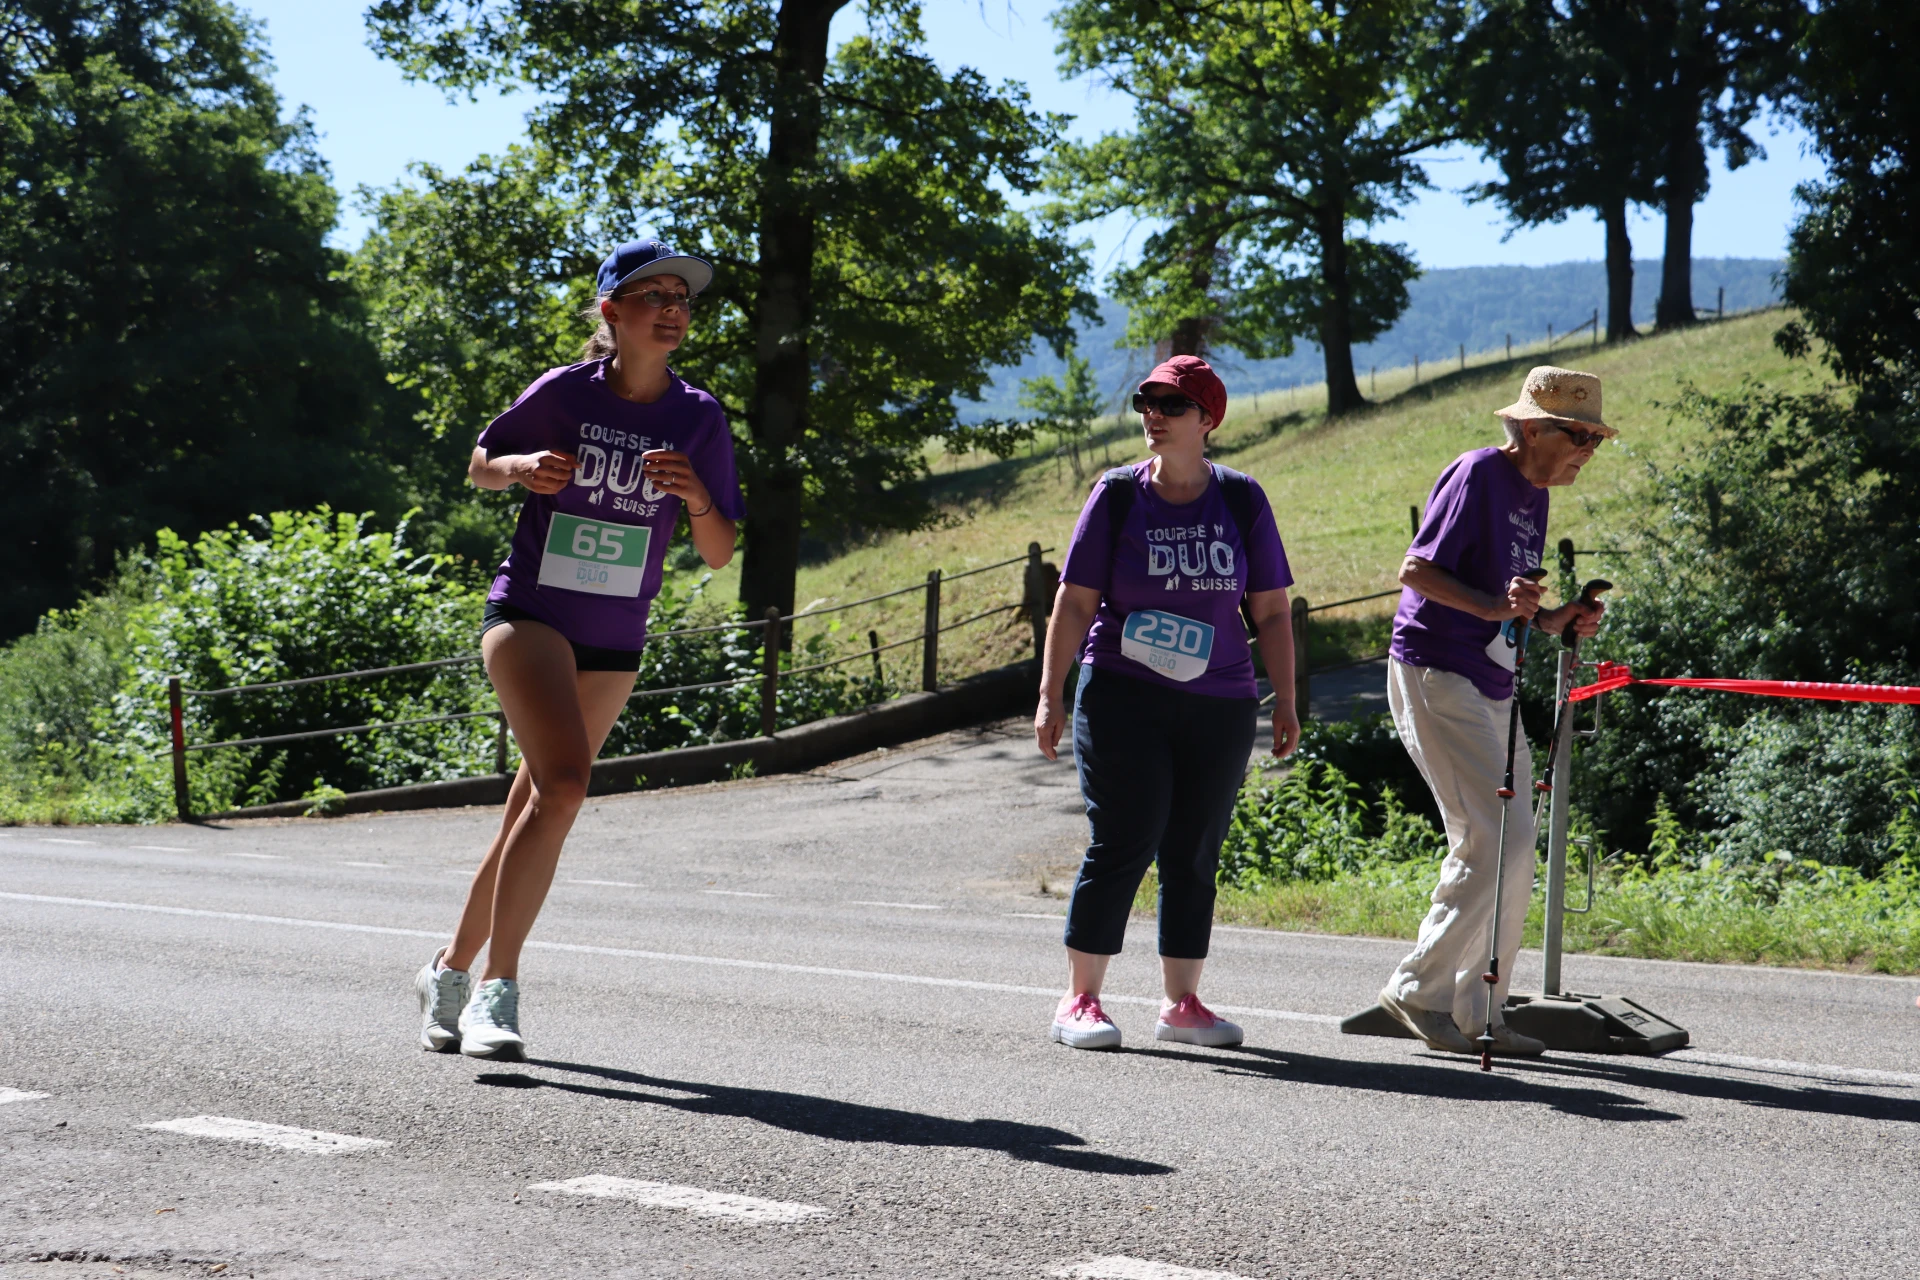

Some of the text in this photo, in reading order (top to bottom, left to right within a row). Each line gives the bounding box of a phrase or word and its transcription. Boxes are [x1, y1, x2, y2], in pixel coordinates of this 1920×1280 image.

[580, 422, 652, 451] COURSE
[571, 523, 625, 561] 65
[1145, 524, 1207, 542] COURSE
[1147, 540, 1235, 577] DUO
[576, 567, 609, 584] DUO
[1191, 578, 1238, 591] SUISSE
[1133, 613, 1204, 655] 230
